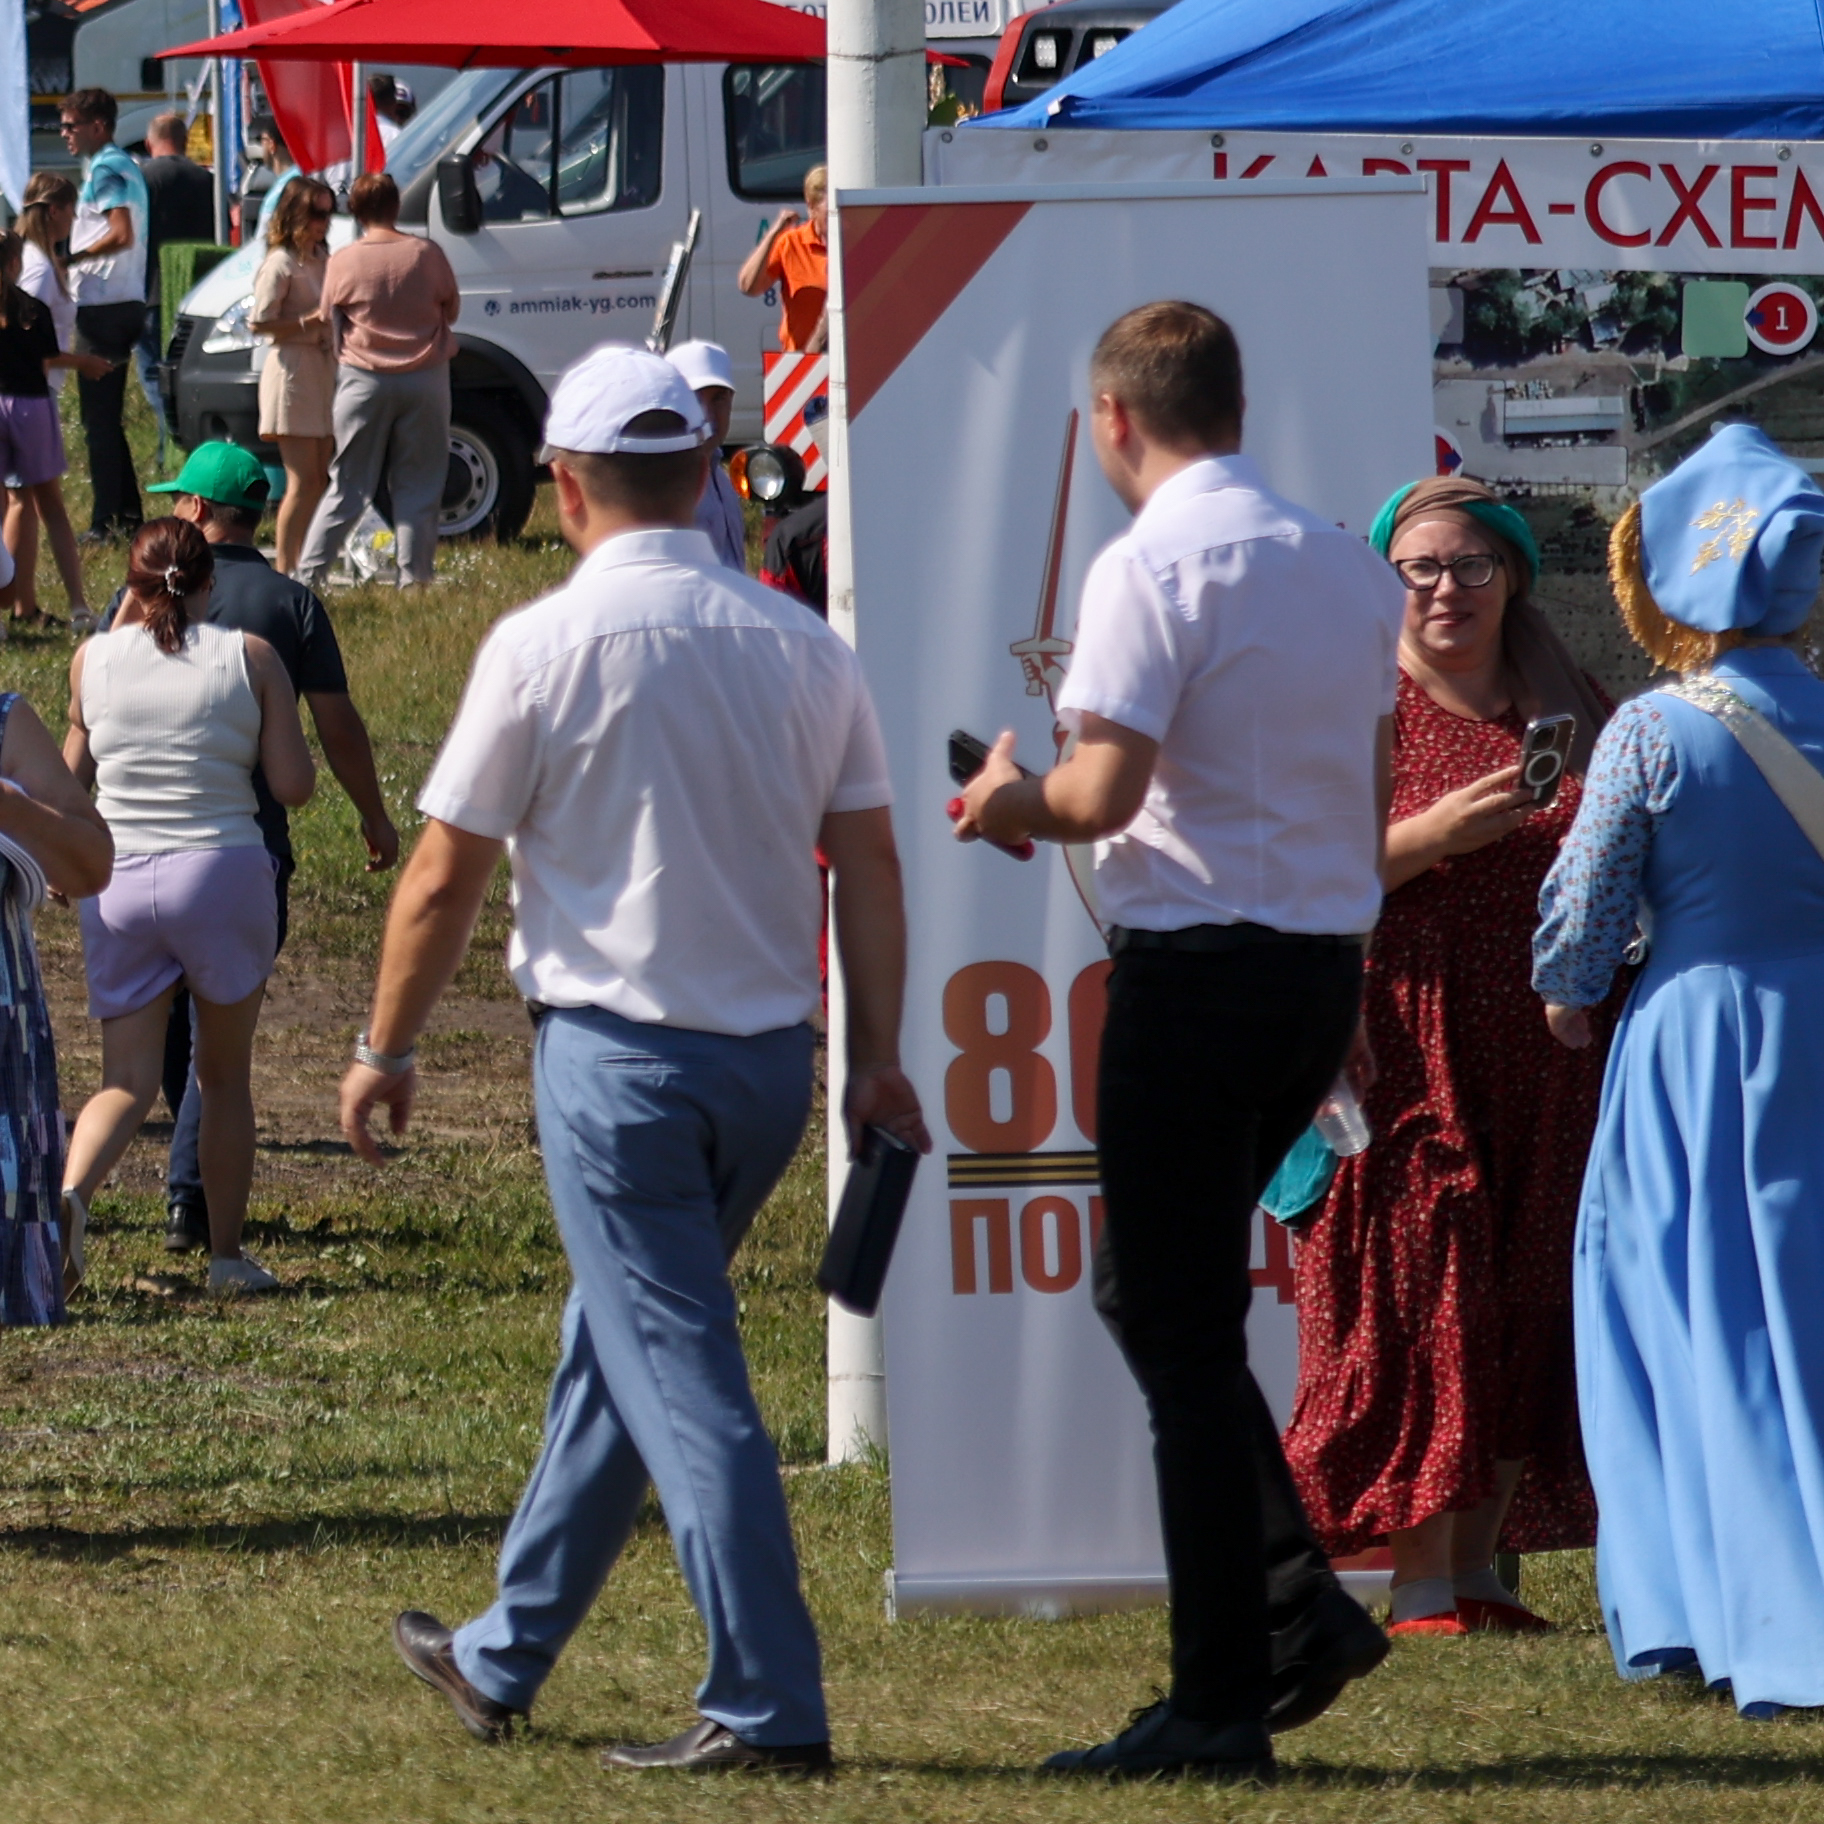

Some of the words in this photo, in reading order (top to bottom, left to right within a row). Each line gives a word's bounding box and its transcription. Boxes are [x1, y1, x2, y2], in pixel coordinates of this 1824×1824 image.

[1213, 151, 1824, 252] ТА-СХЕ
[510, 294, 656, 316] ammiak-yg.com
[1776, 305, 1789, 331] 1
